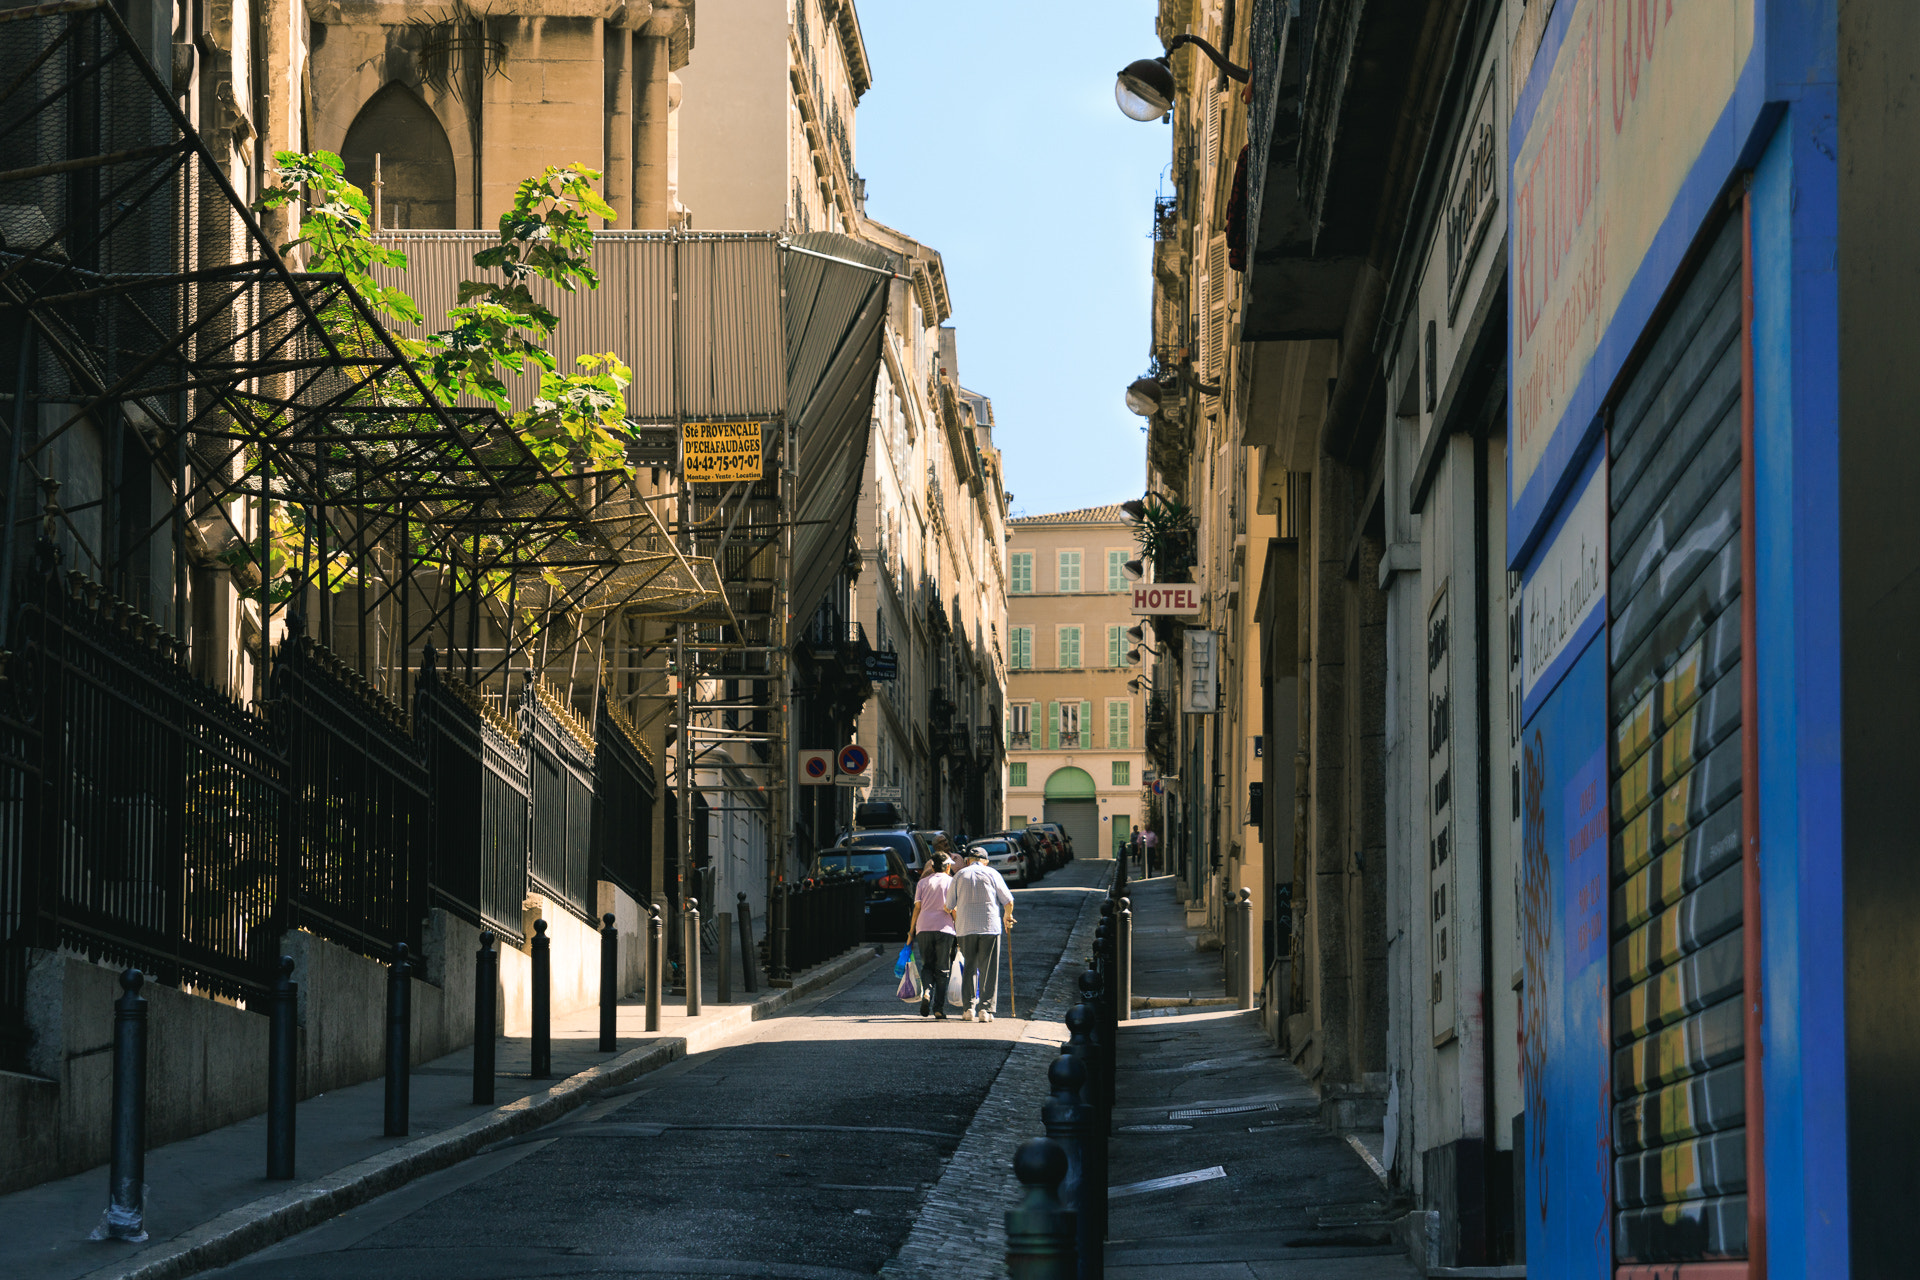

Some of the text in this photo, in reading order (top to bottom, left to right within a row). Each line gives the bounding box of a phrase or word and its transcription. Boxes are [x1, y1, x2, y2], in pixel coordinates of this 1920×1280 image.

[1553, 209, 1610, 395] repassage
[685, 423, 760, 439] Sté PROVENÇALE
[685, 438, 761, 454] D'ECHAFAUDAGES
[686, 454, 760, 472] 04-42-75-07-07
[686, 473, 711, 481] Montage
[735, 471, 761, 480] Location
[1134, 589, 1197, 609] HOTEL
